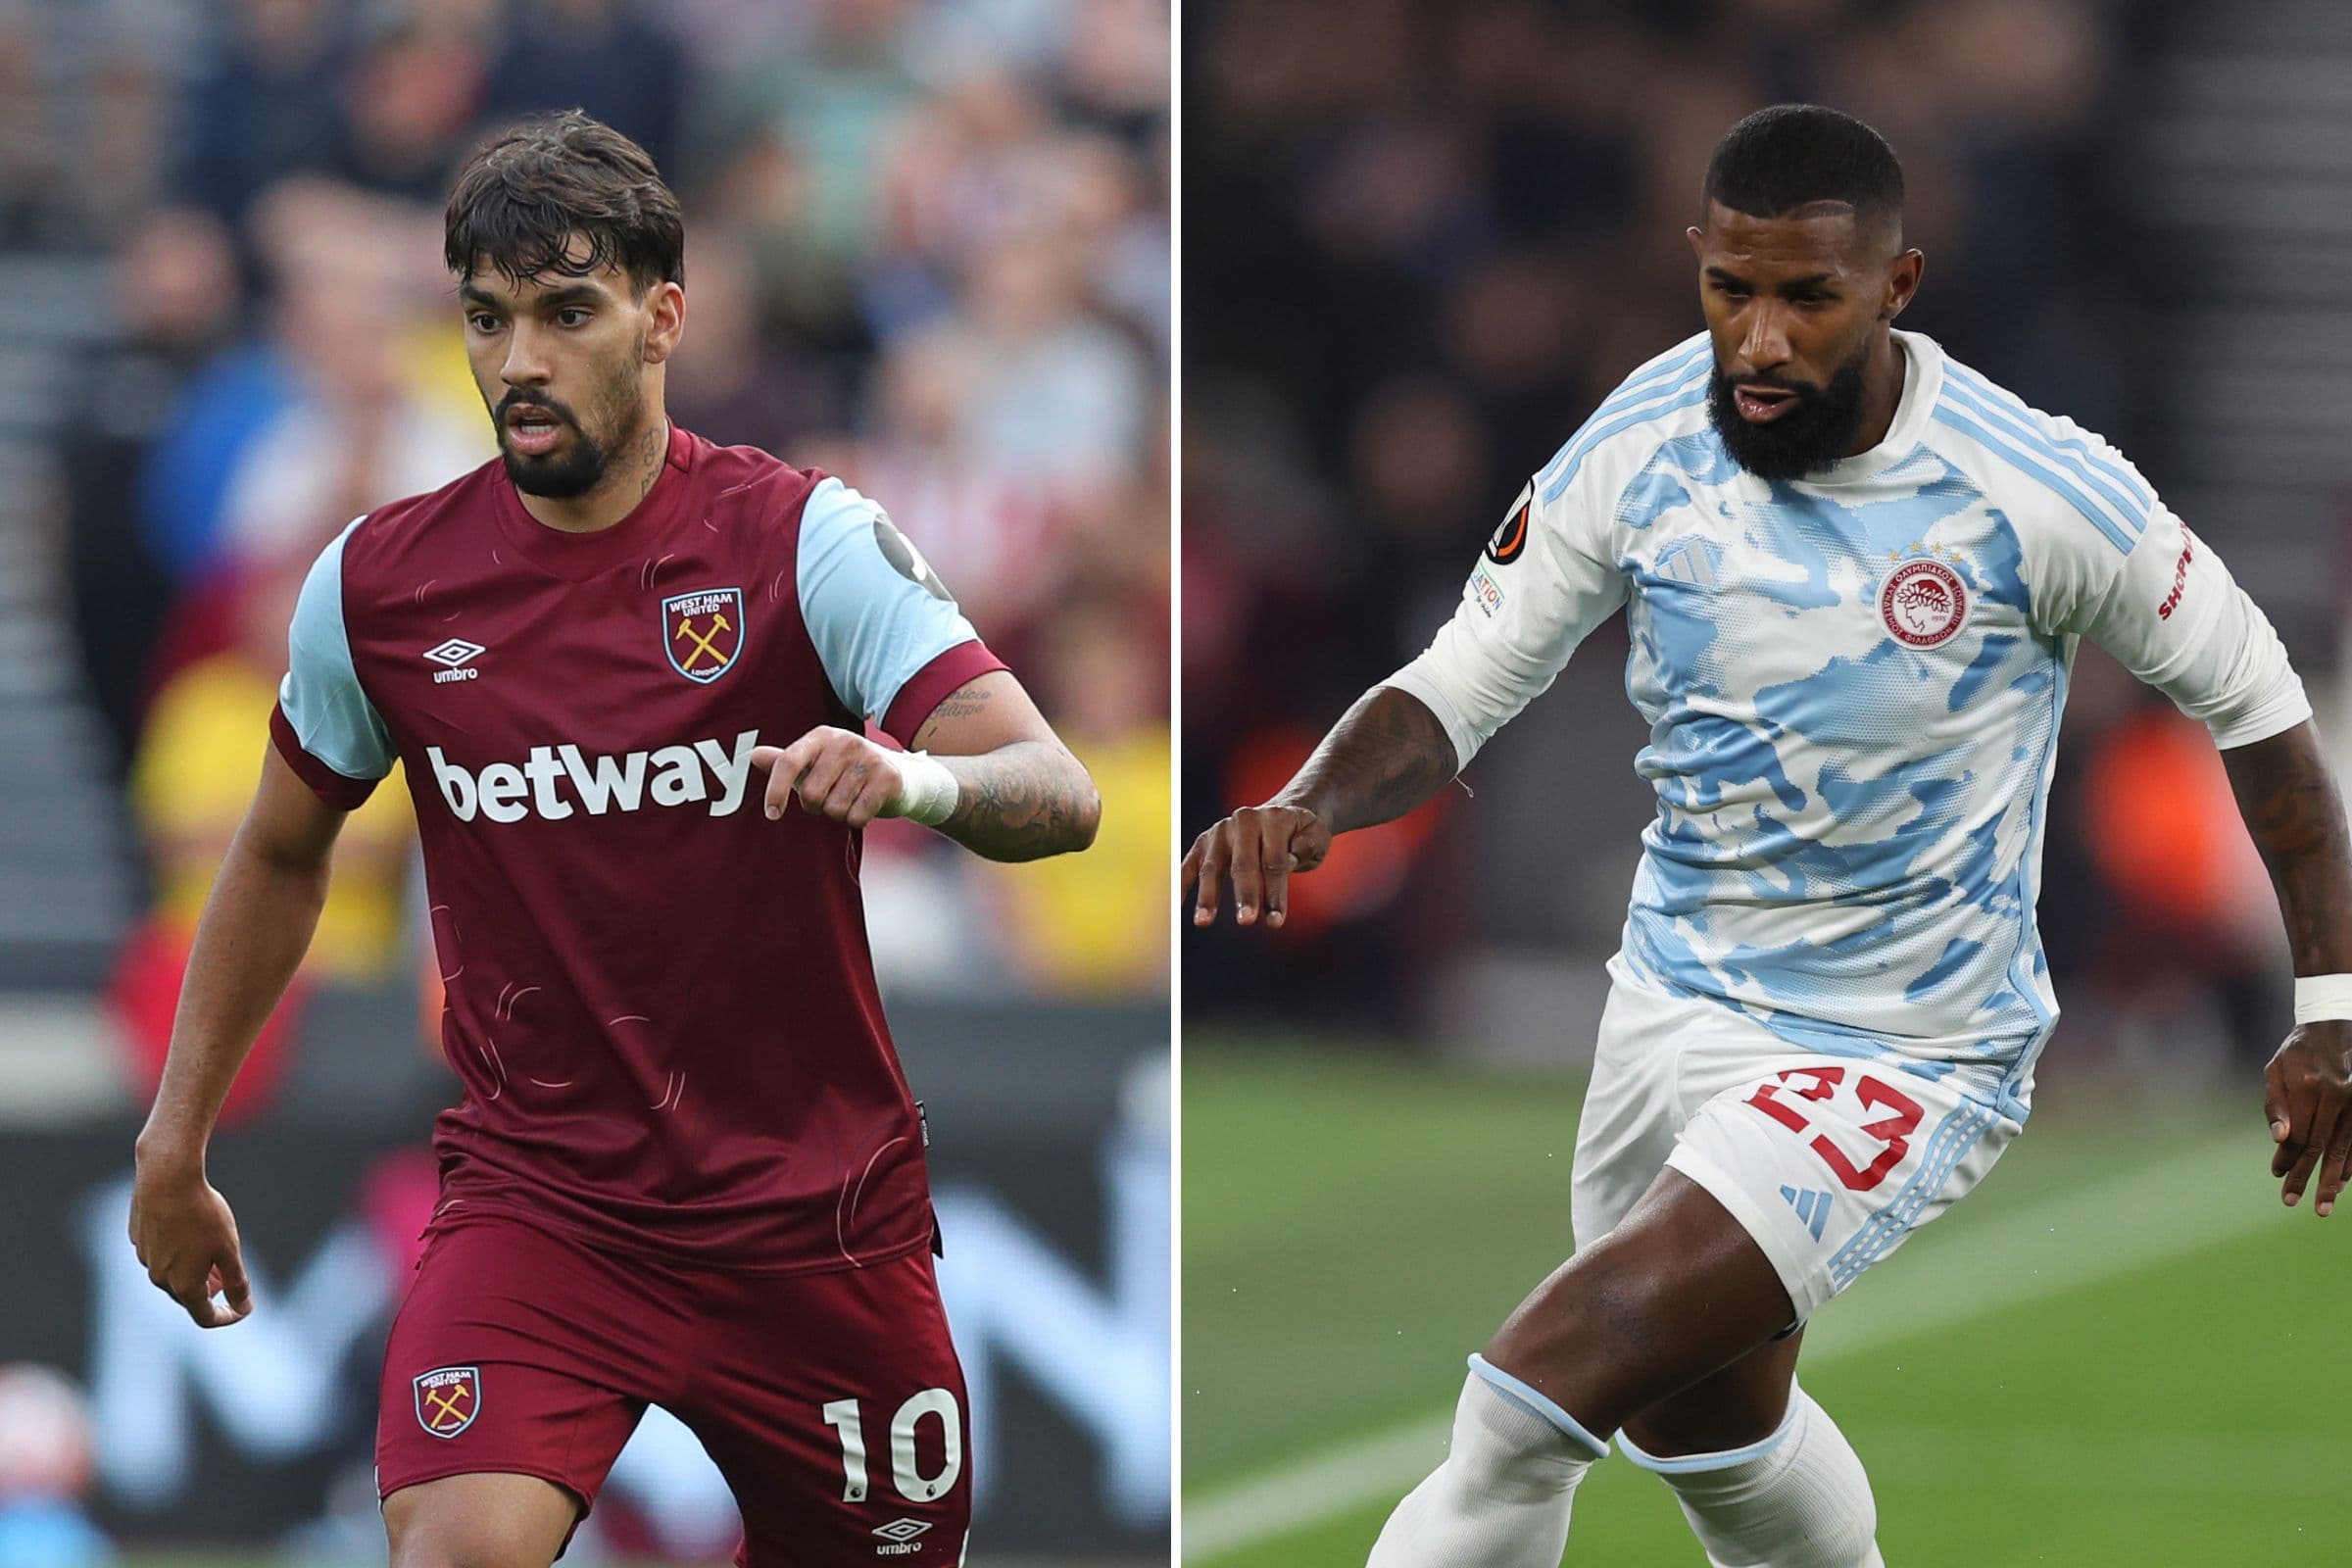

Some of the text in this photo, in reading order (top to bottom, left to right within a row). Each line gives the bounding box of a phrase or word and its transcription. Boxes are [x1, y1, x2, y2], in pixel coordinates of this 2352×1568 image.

[1895, 564, 1954, 583] ΟΛΥΜΠΙΑΚΟΣ
[669, 593, 733, 612] WEST HAM
[682, 604, 720, 617] UNITED
[433, 667, 478, 683] umbro
[425, 729, 760, 823] betway
[1741, 1066, 1926, 1193] 23
[822, 1388, 961, 1502] 10
[876, 1542, 922, 1555] umbro
